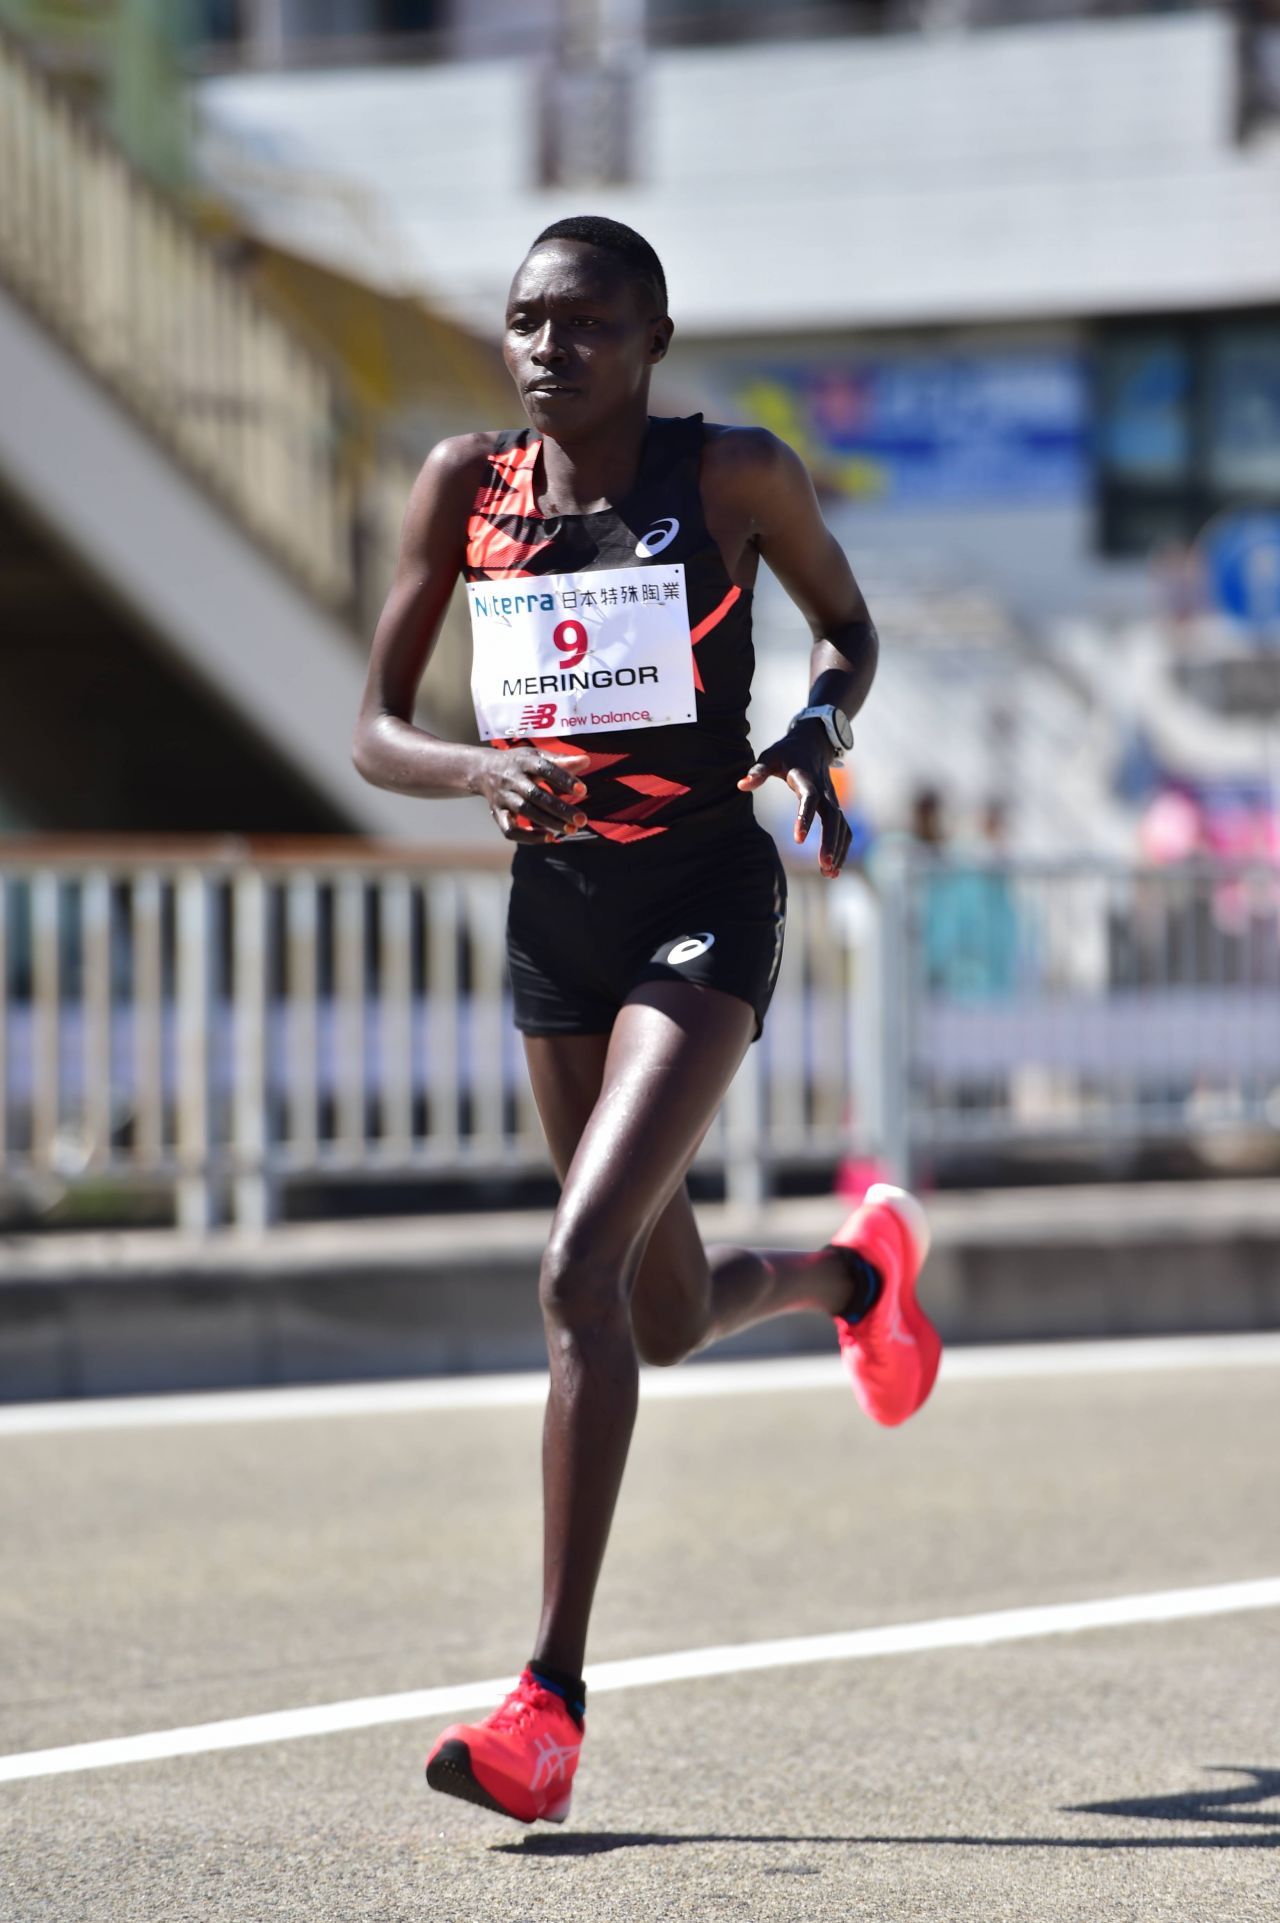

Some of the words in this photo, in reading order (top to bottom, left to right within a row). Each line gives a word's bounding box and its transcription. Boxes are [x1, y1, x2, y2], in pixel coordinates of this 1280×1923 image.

[562, 582, 680, 609] 日本特殊陶業
[553, 619, 588, 669] 9
[502, 666, 659, 696] MERINGOR
[561, 717, 587, 728] new
[591, 709, 650, 725] balance
